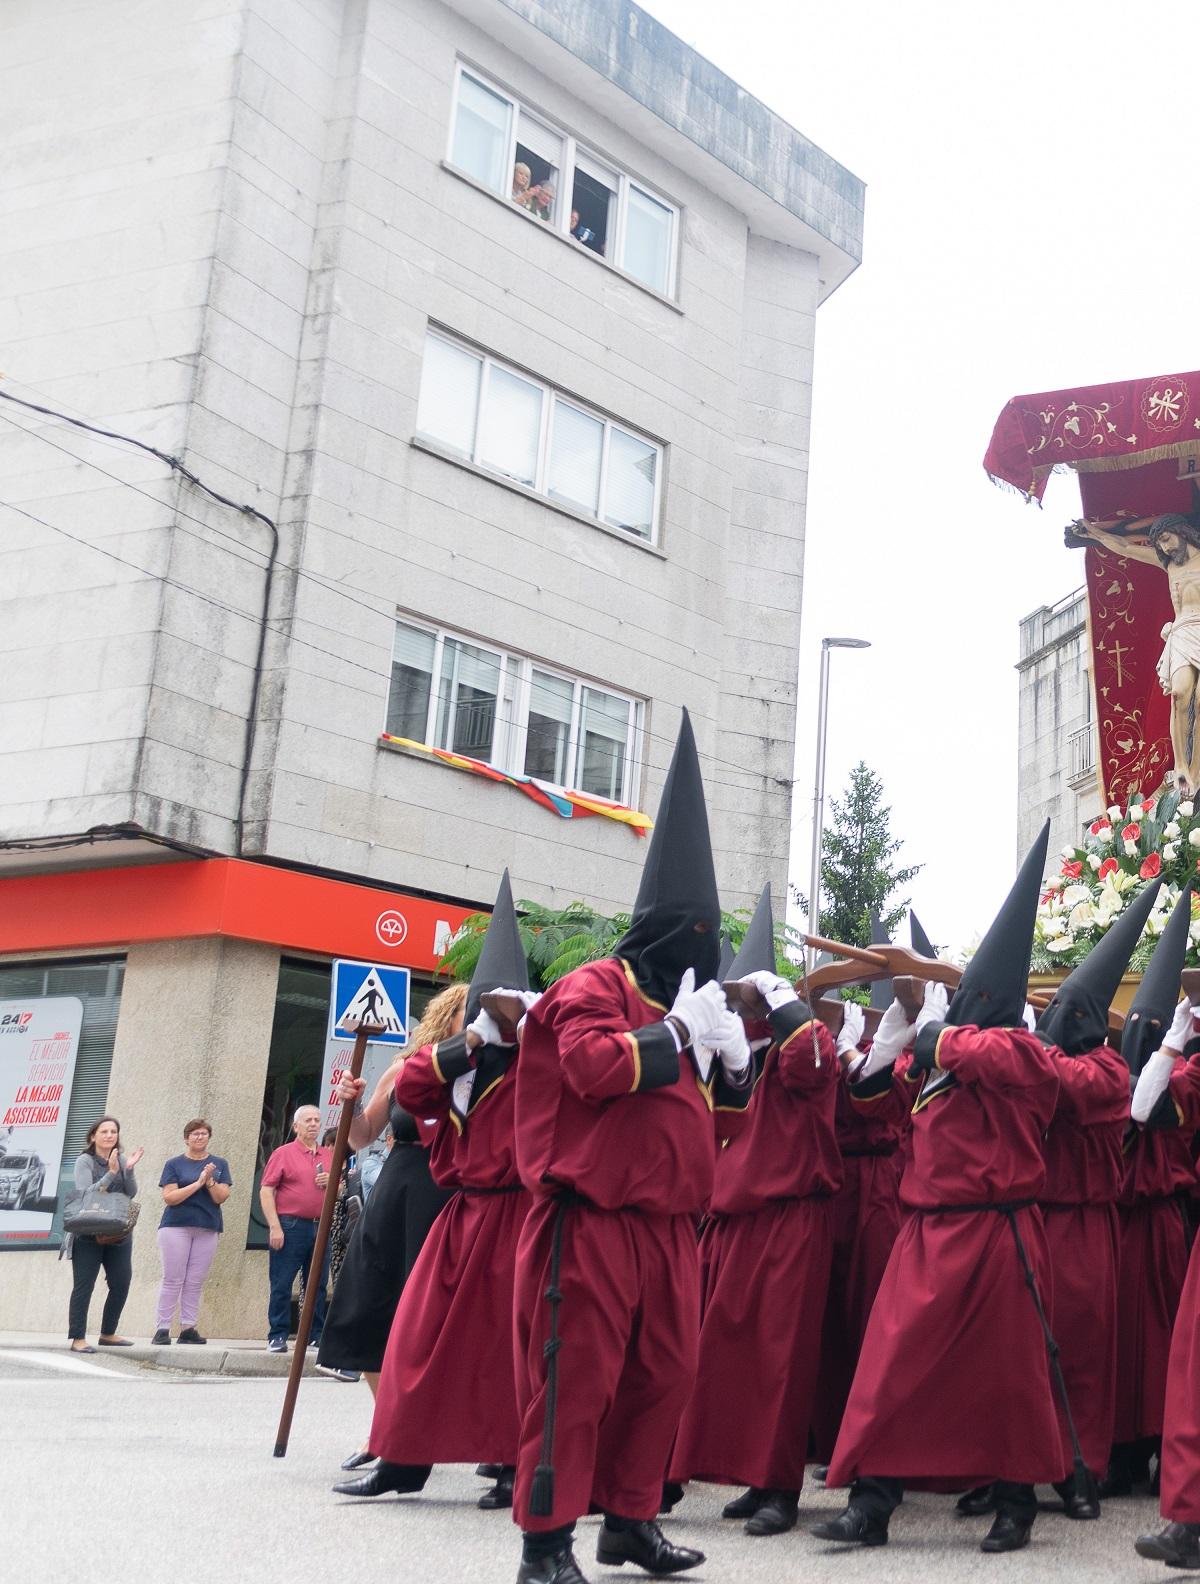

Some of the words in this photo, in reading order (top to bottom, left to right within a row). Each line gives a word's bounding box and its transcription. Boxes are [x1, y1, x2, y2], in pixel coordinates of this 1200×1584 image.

[15, 1086, 29, 1103] LA
[29, 1084, 64, 1102] MEJOR
[3, 1106, 61, 1125] ASISTENCIA
